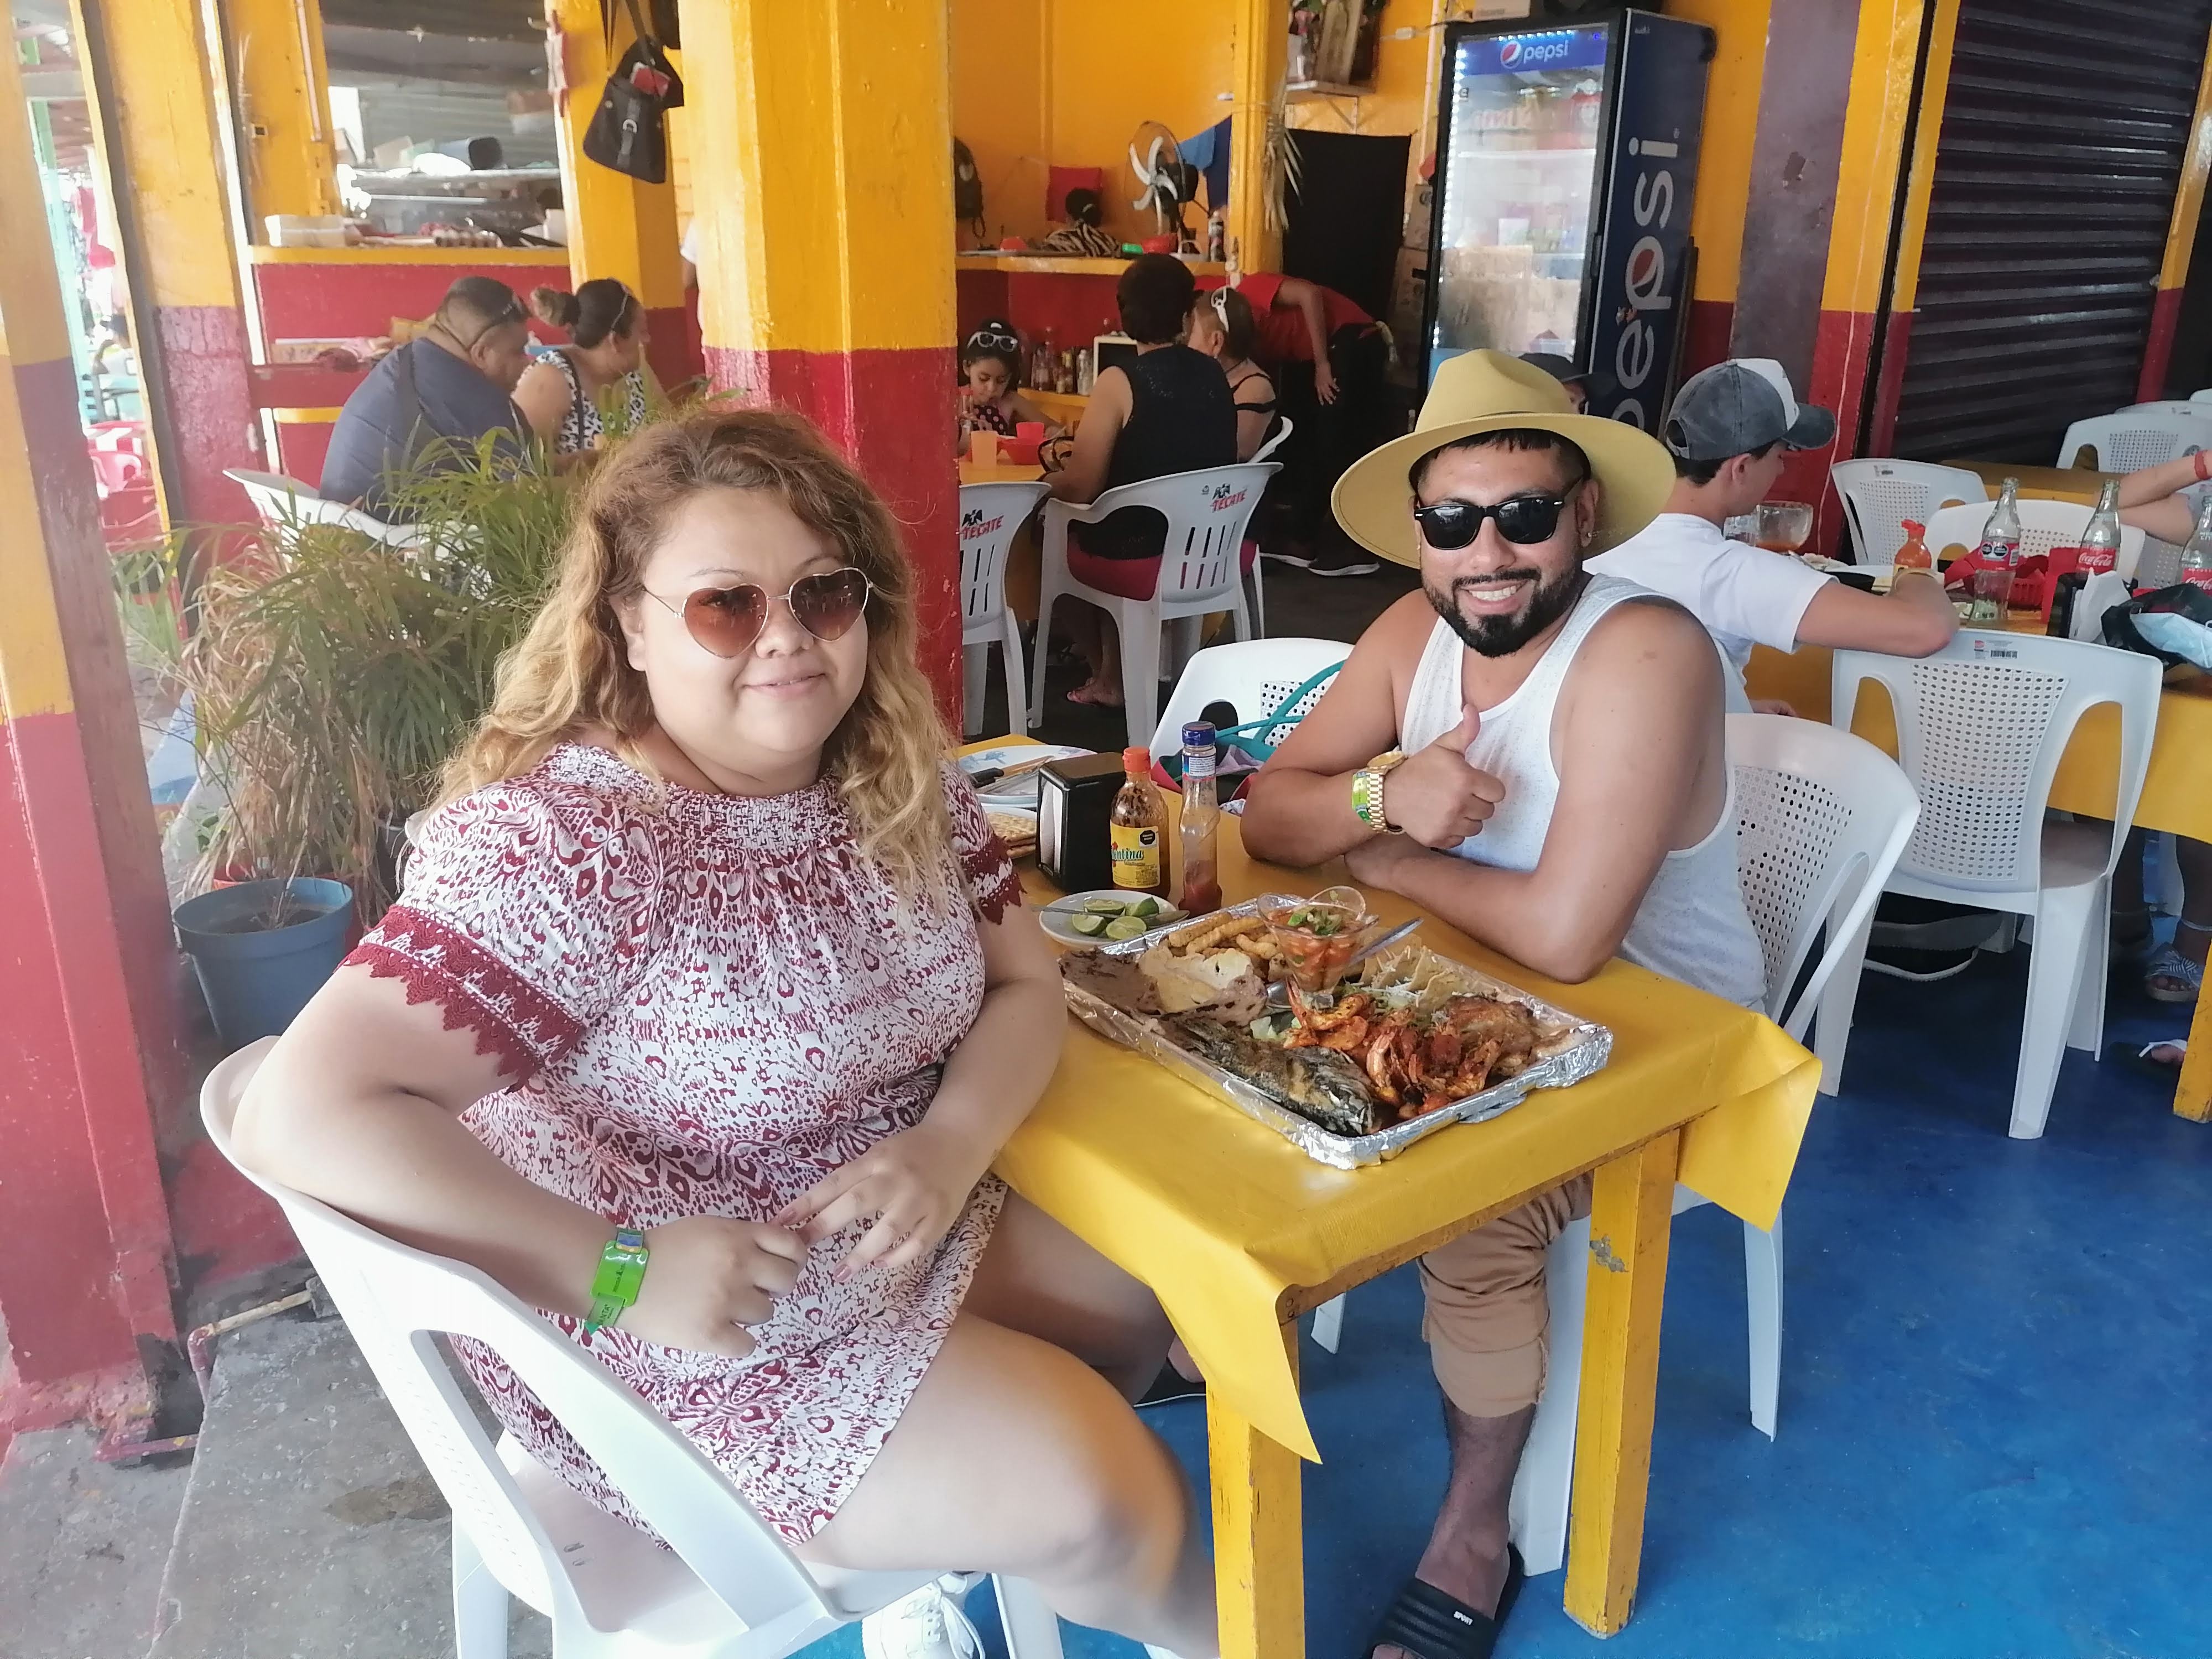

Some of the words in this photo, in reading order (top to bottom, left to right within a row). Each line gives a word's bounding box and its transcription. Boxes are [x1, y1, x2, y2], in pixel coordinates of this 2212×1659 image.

[1523, 40, 1569, 64] pepsi
[962, 515, 1004, 540] TECATE
[1453, 1611, 1473, 1625] SPORT
